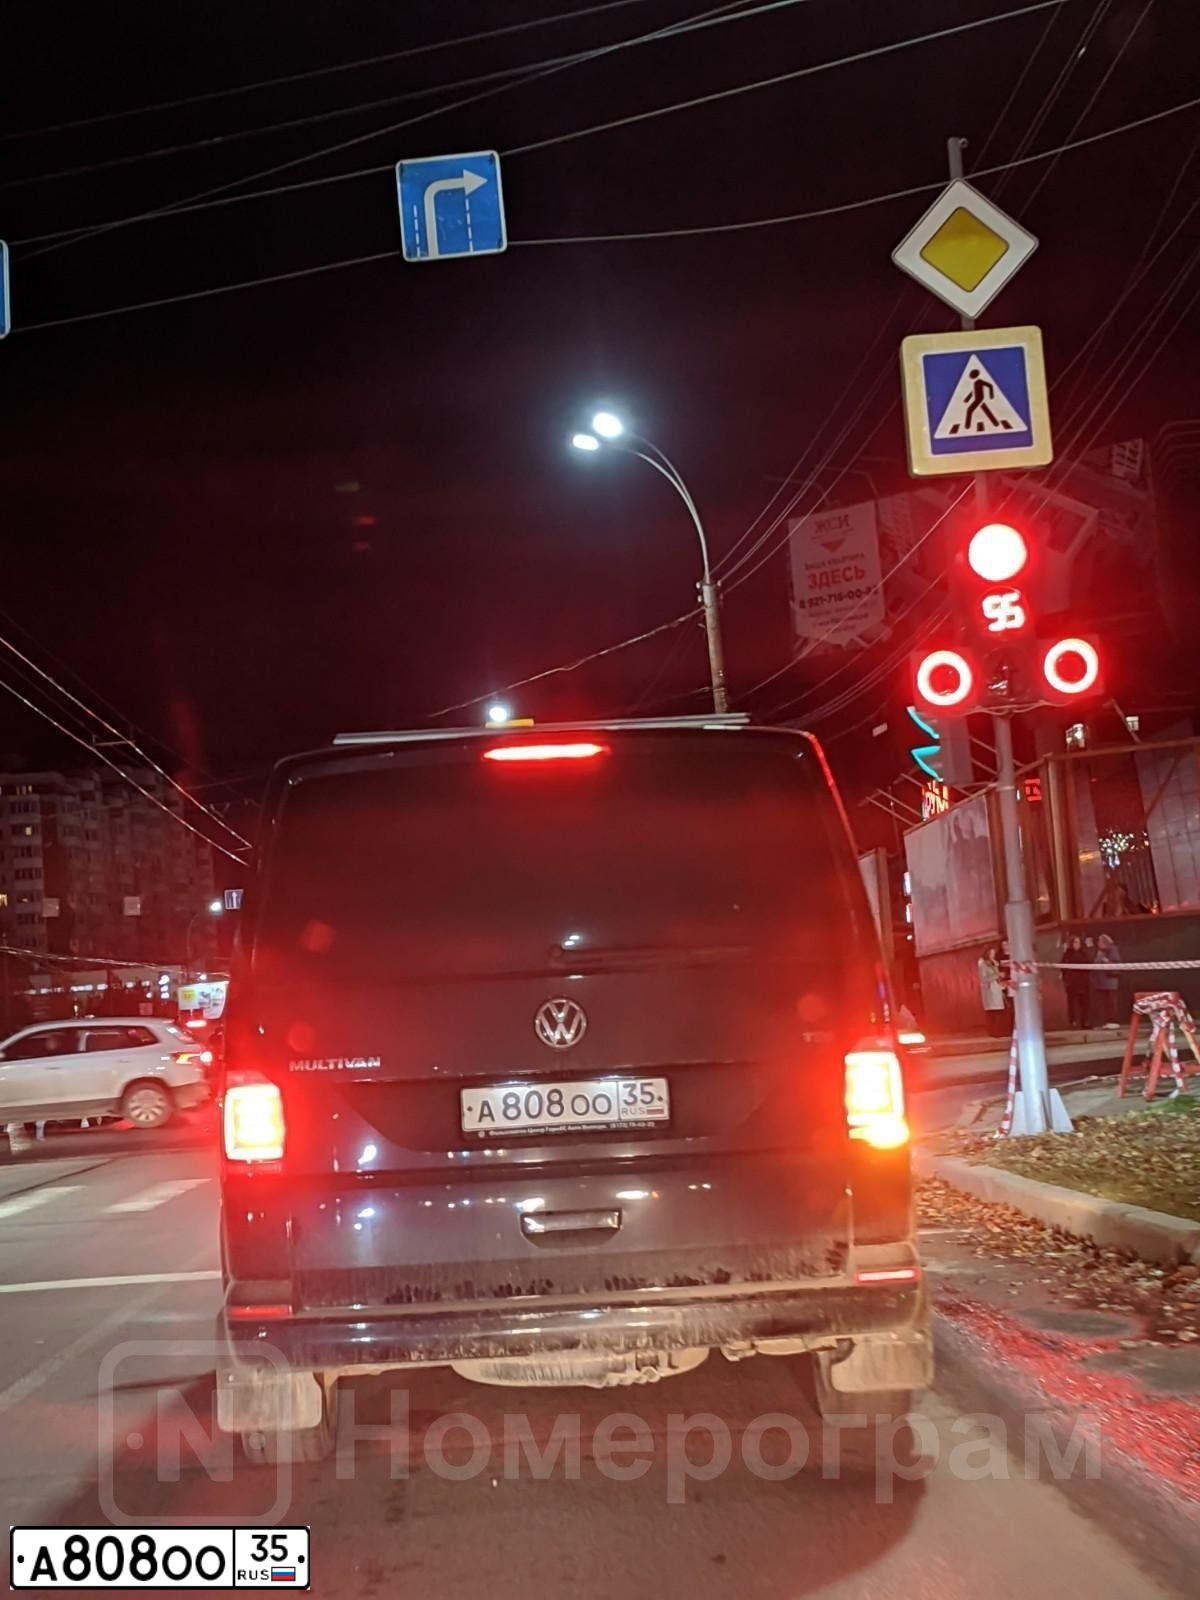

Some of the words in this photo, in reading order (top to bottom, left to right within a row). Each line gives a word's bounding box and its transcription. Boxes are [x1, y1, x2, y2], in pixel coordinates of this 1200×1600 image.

[808, 565, 866, 589] ЗДЕСЬ
[288, 1056, 381, 1071] MULTIVAN
[622, 1082, 654, 1105] 35
[621, 1106, 645, 1116] RUS
